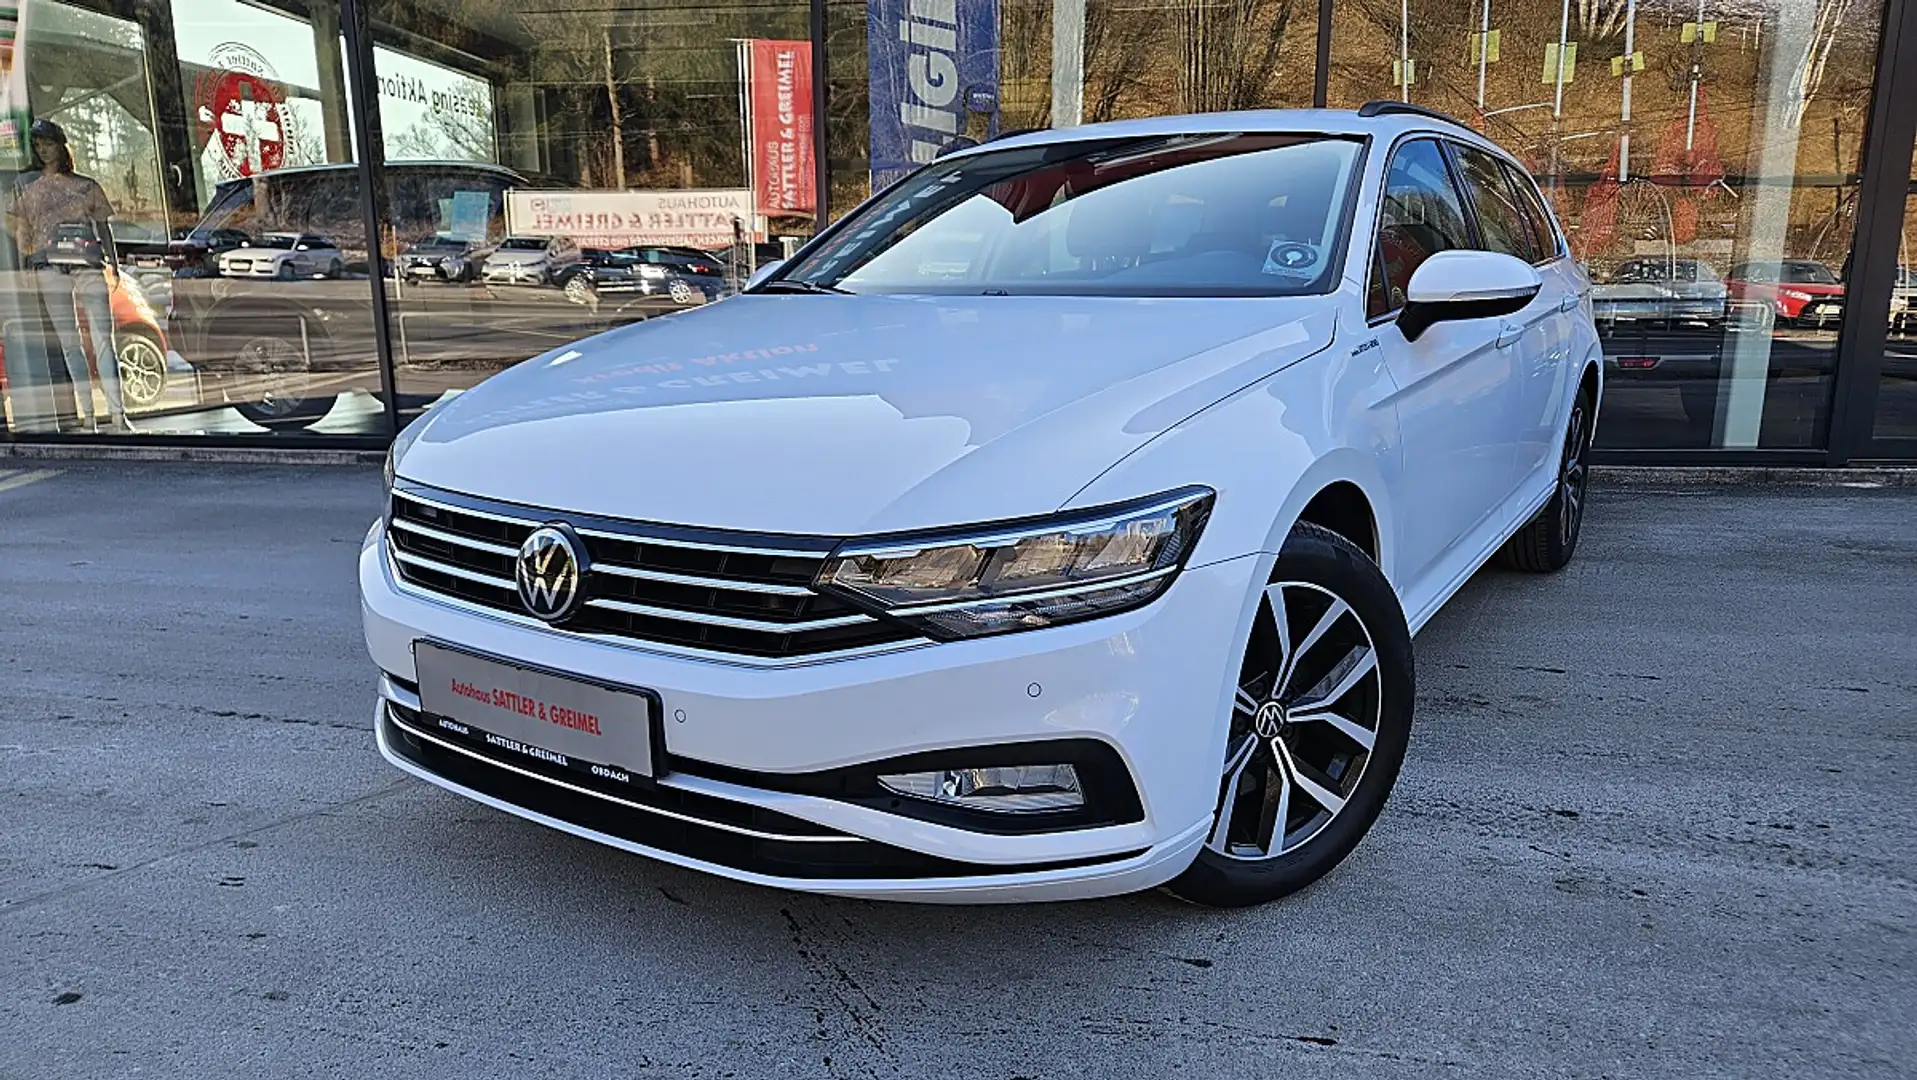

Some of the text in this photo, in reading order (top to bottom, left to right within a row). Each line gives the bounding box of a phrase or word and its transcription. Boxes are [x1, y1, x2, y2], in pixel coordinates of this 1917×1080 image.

[777, 50, 795, 209] SATTLER & GREIMEL
[451, 678, 602, 736] Autohaus SATTLER & GREIMEL
[439, 718, 469, 735] AUTOHAUS
[486, 733, 521, 753] SATTLER
[529, 746, 568, 767] GREIMEL
[591, 765, 629, 784] OBDACH
